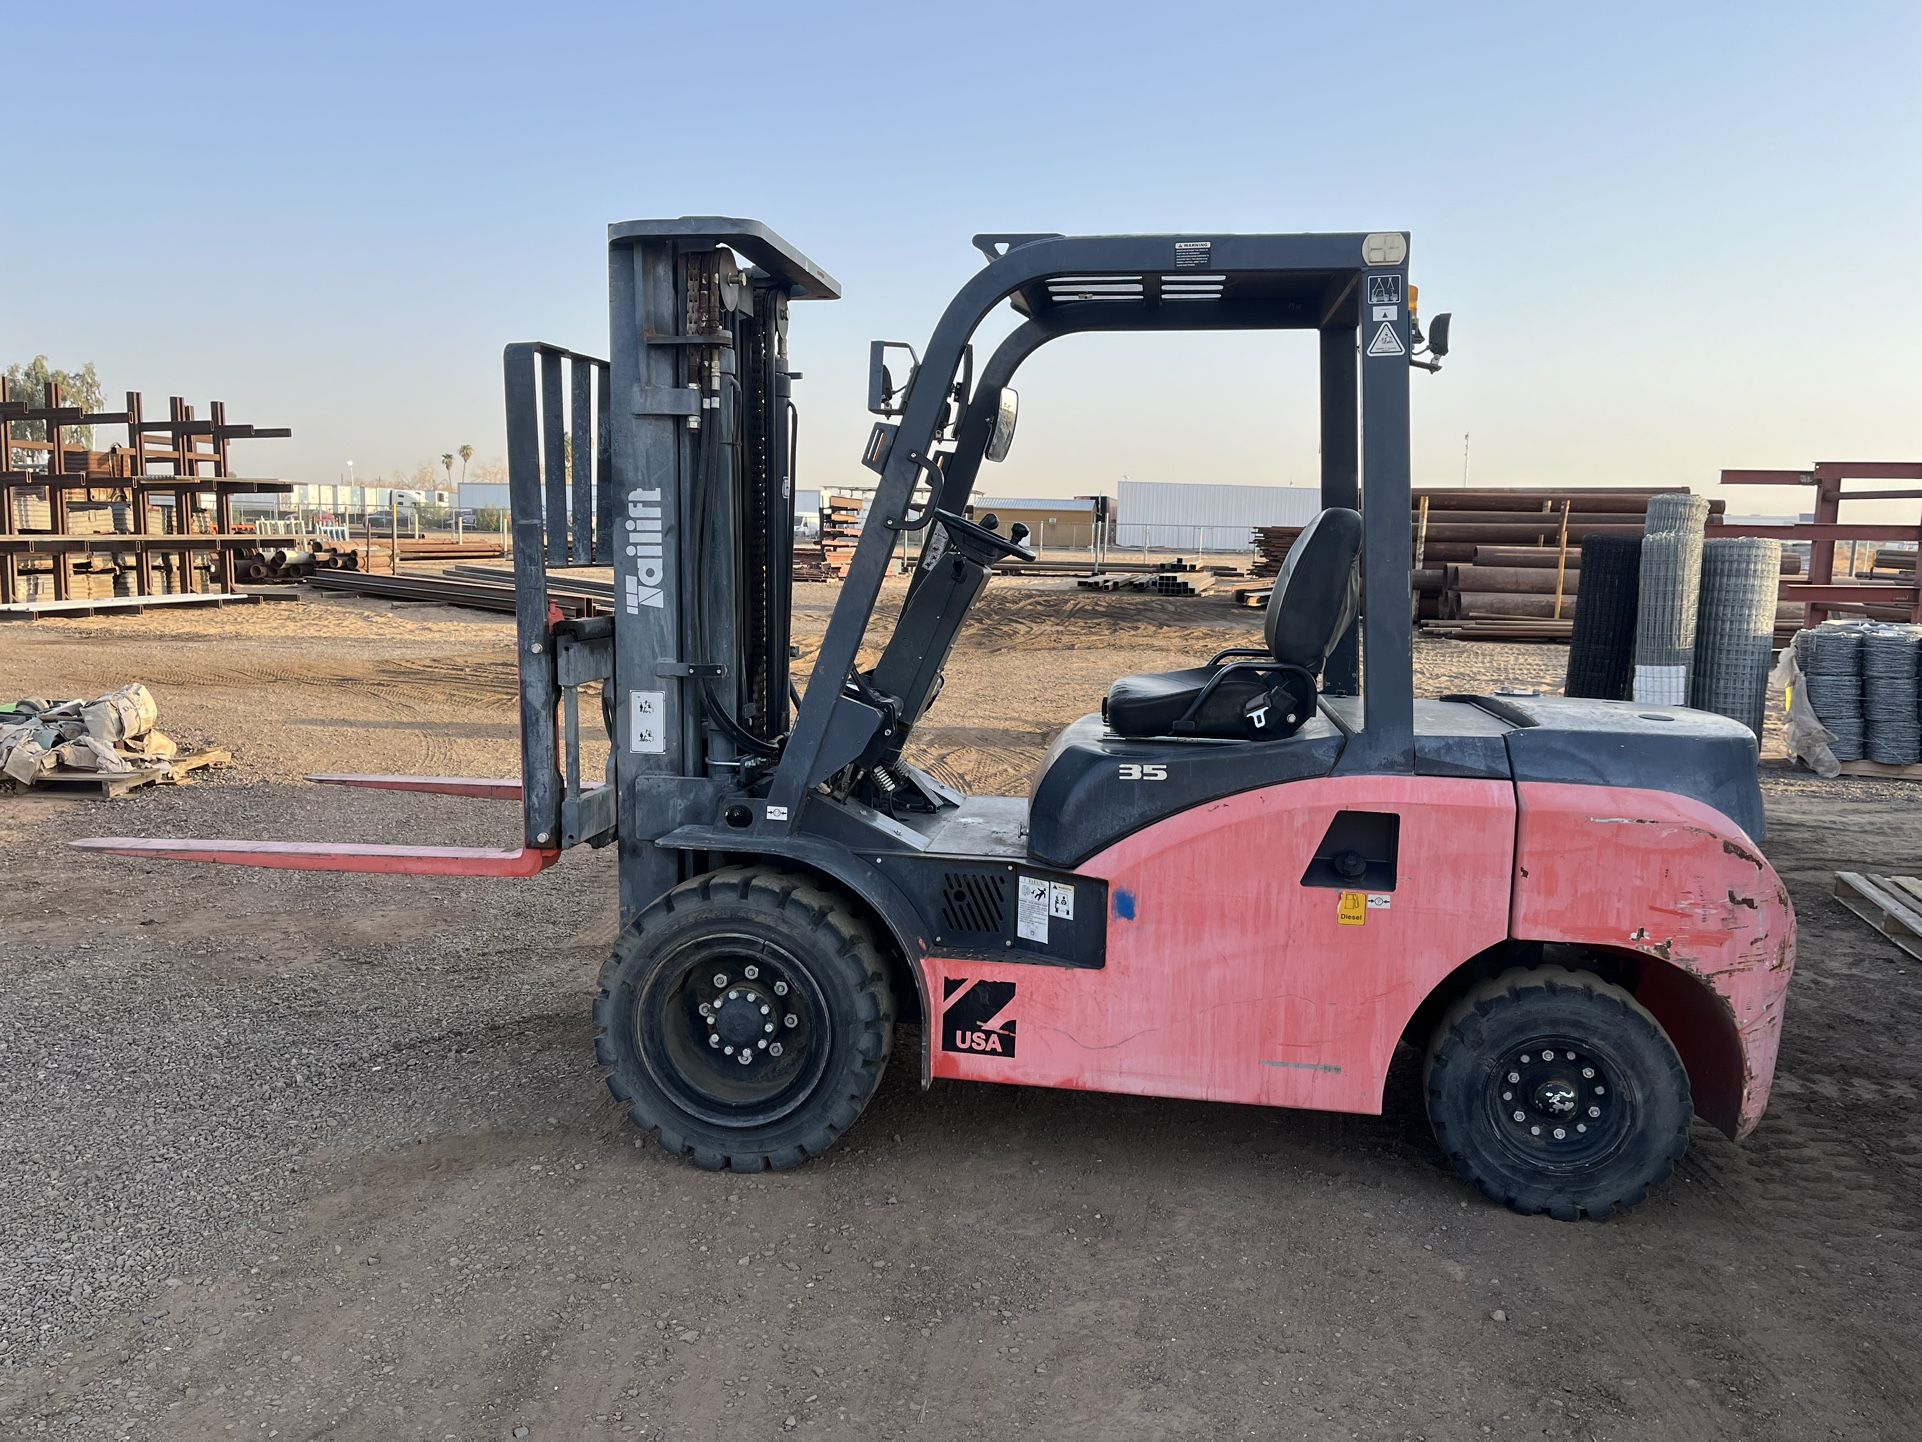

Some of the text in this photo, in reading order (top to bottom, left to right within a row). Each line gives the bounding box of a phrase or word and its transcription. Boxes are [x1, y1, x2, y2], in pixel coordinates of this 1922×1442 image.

[1119, 764, 1168, 780] 35
[1340, 913, 1362, 921] Diesel
[955, 1030, 1002, 1052] USA
